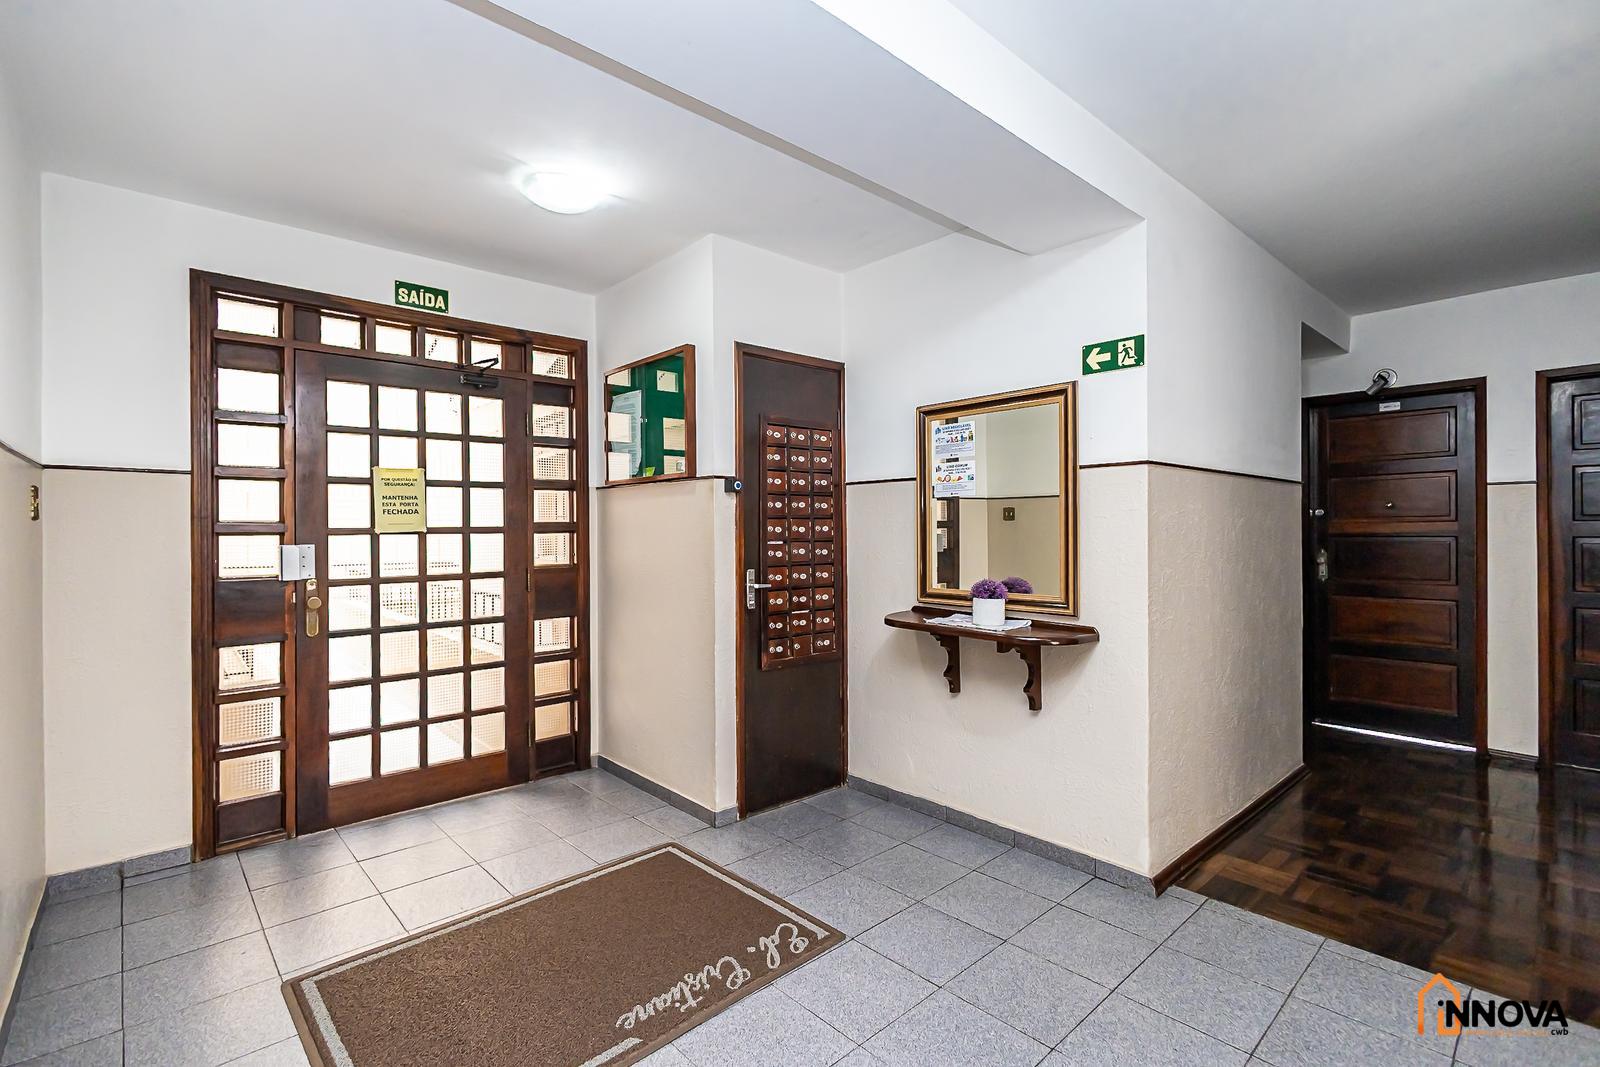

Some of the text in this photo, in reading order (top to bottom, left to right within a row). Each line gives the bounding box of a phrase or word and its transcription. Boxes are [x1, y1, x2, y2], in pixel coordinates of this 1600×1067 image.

[398, 287, 446, 310] SAÍDA
[615, 922, 810, 1029] Ed. Cristiane
